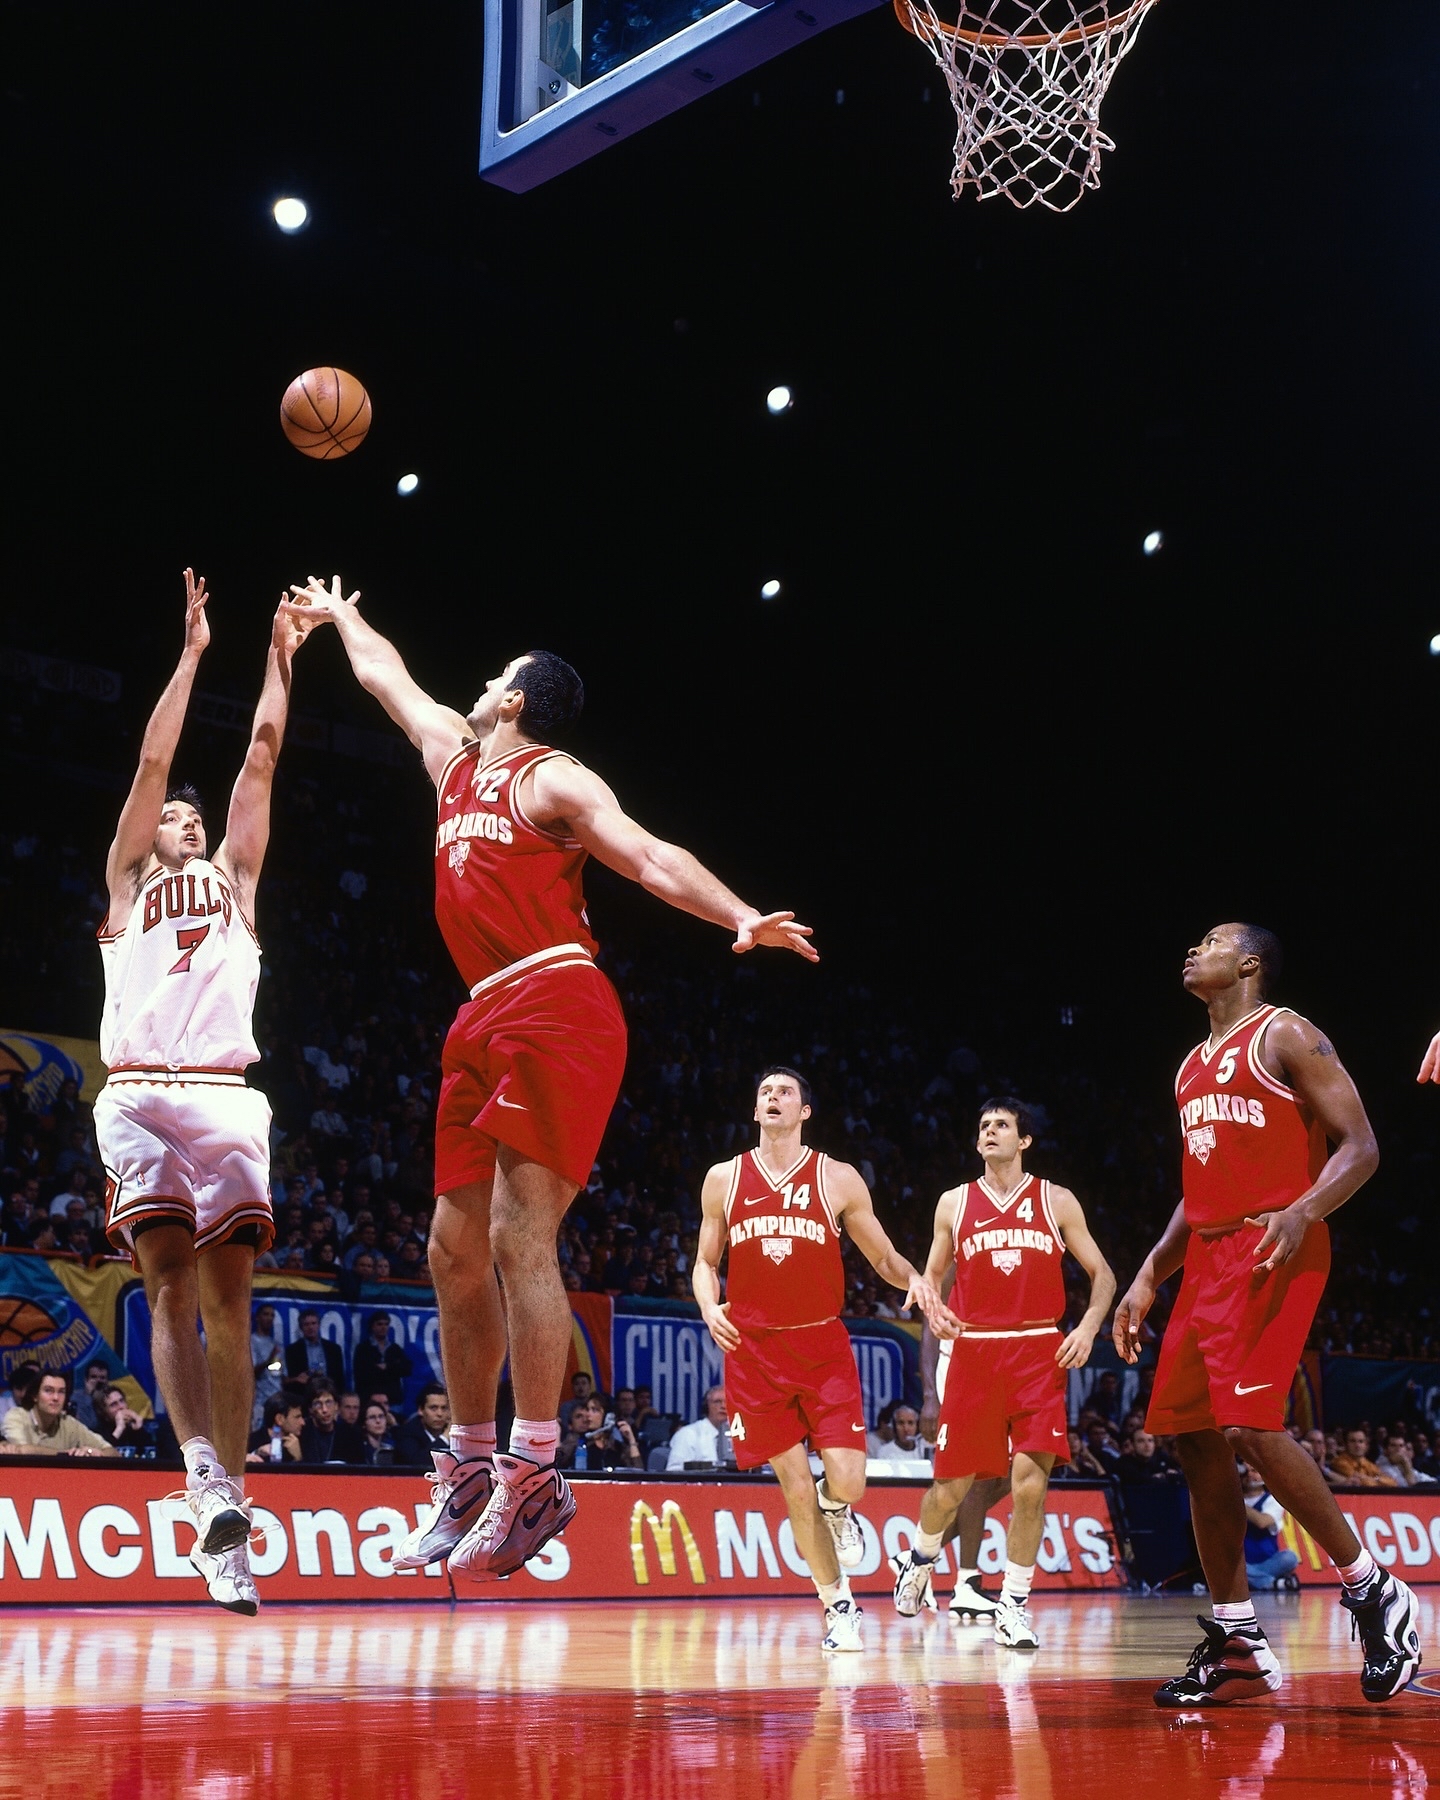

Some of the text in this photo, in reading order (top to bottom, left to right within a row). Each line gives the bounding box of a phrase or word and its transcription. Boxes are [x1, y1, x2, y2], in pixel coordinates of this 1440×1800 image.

[143, 874, 232, 934] BULLS
[167, 923, 210, 976] 7
[1215, 1046, 1241, 1085] 5
[780, 1182, 811, 1210] 14
[1016, 1197, 1035, 1223] 4
[730, 1215, 826, 1248] OLYMPIAKOS
[962, 1228, 1054, 1261] OLYMPIAKOS
[936, 1423, 949, 1451] 4
